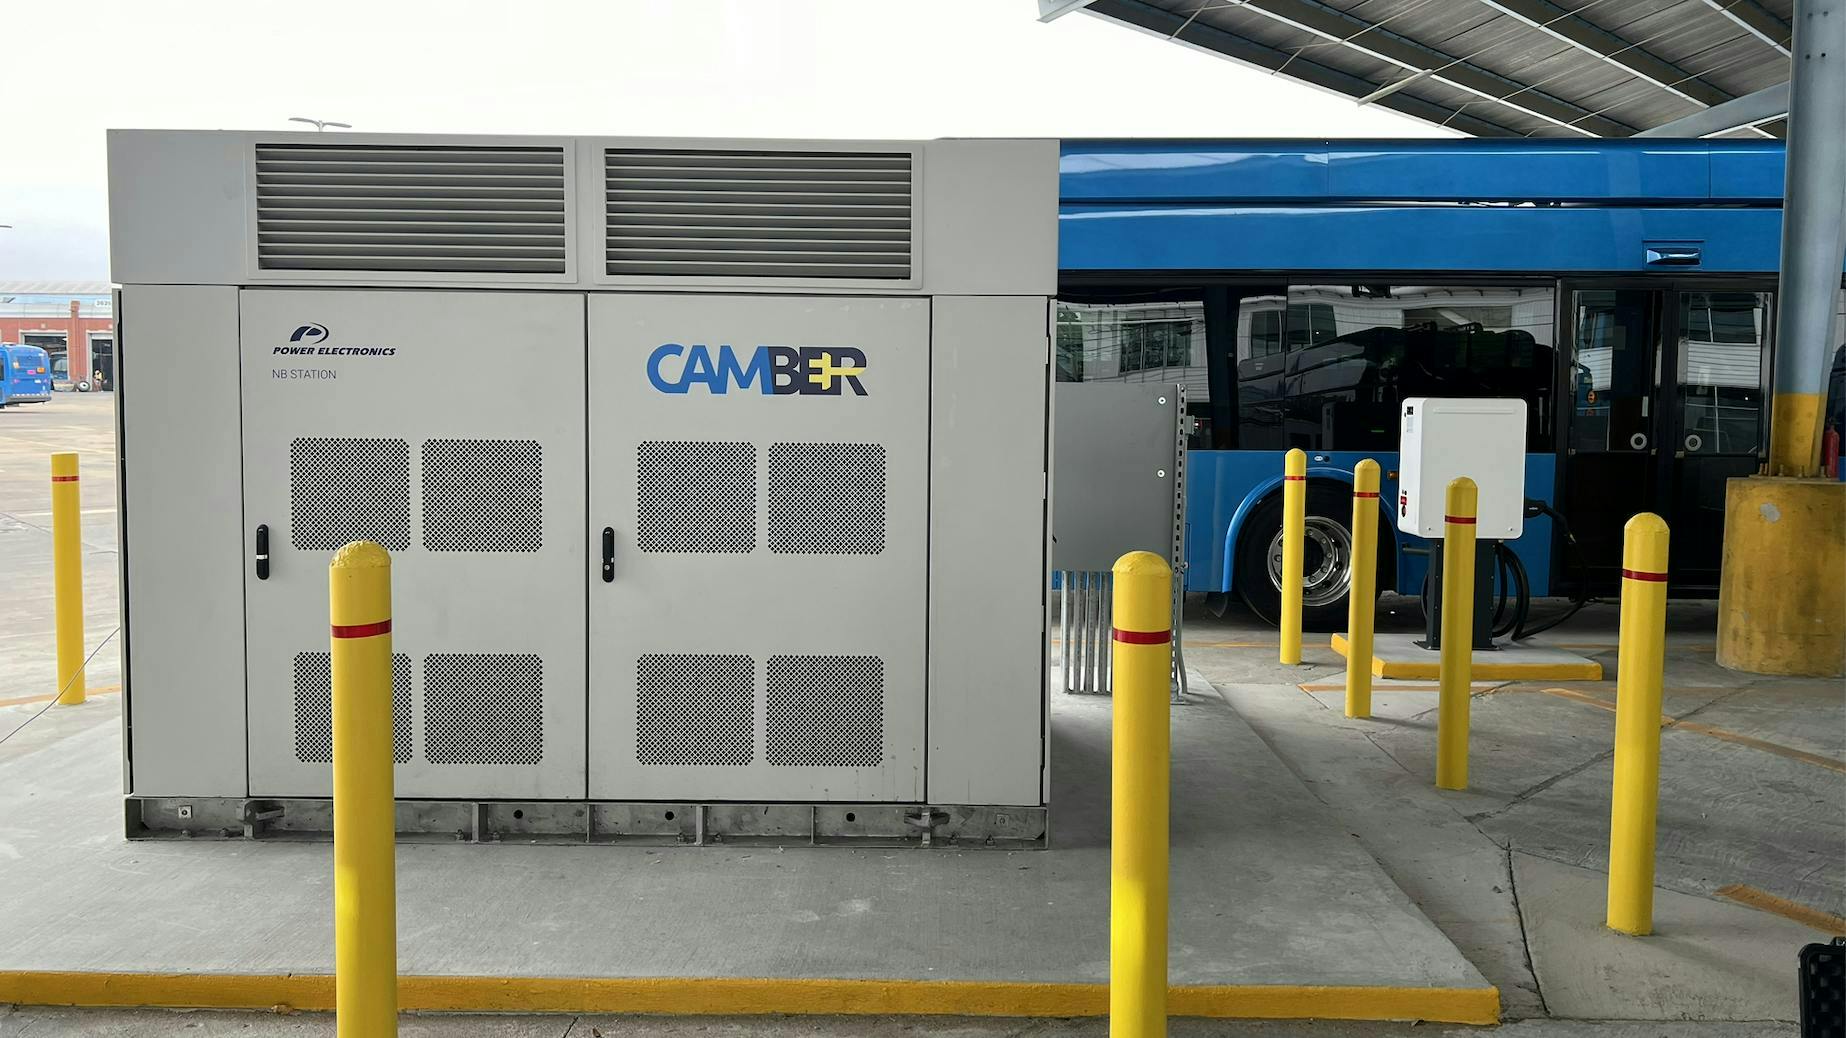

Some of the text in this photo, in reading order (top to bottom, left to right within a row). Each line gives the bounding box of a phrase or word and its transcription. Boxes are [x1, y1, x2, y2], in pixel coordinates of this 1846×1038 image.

[272, 346, 396, 356] POWER ELECTRONICS
[272, 369, 337, 380] NB STATION
[646, 343, 869, 396] CAMBER
